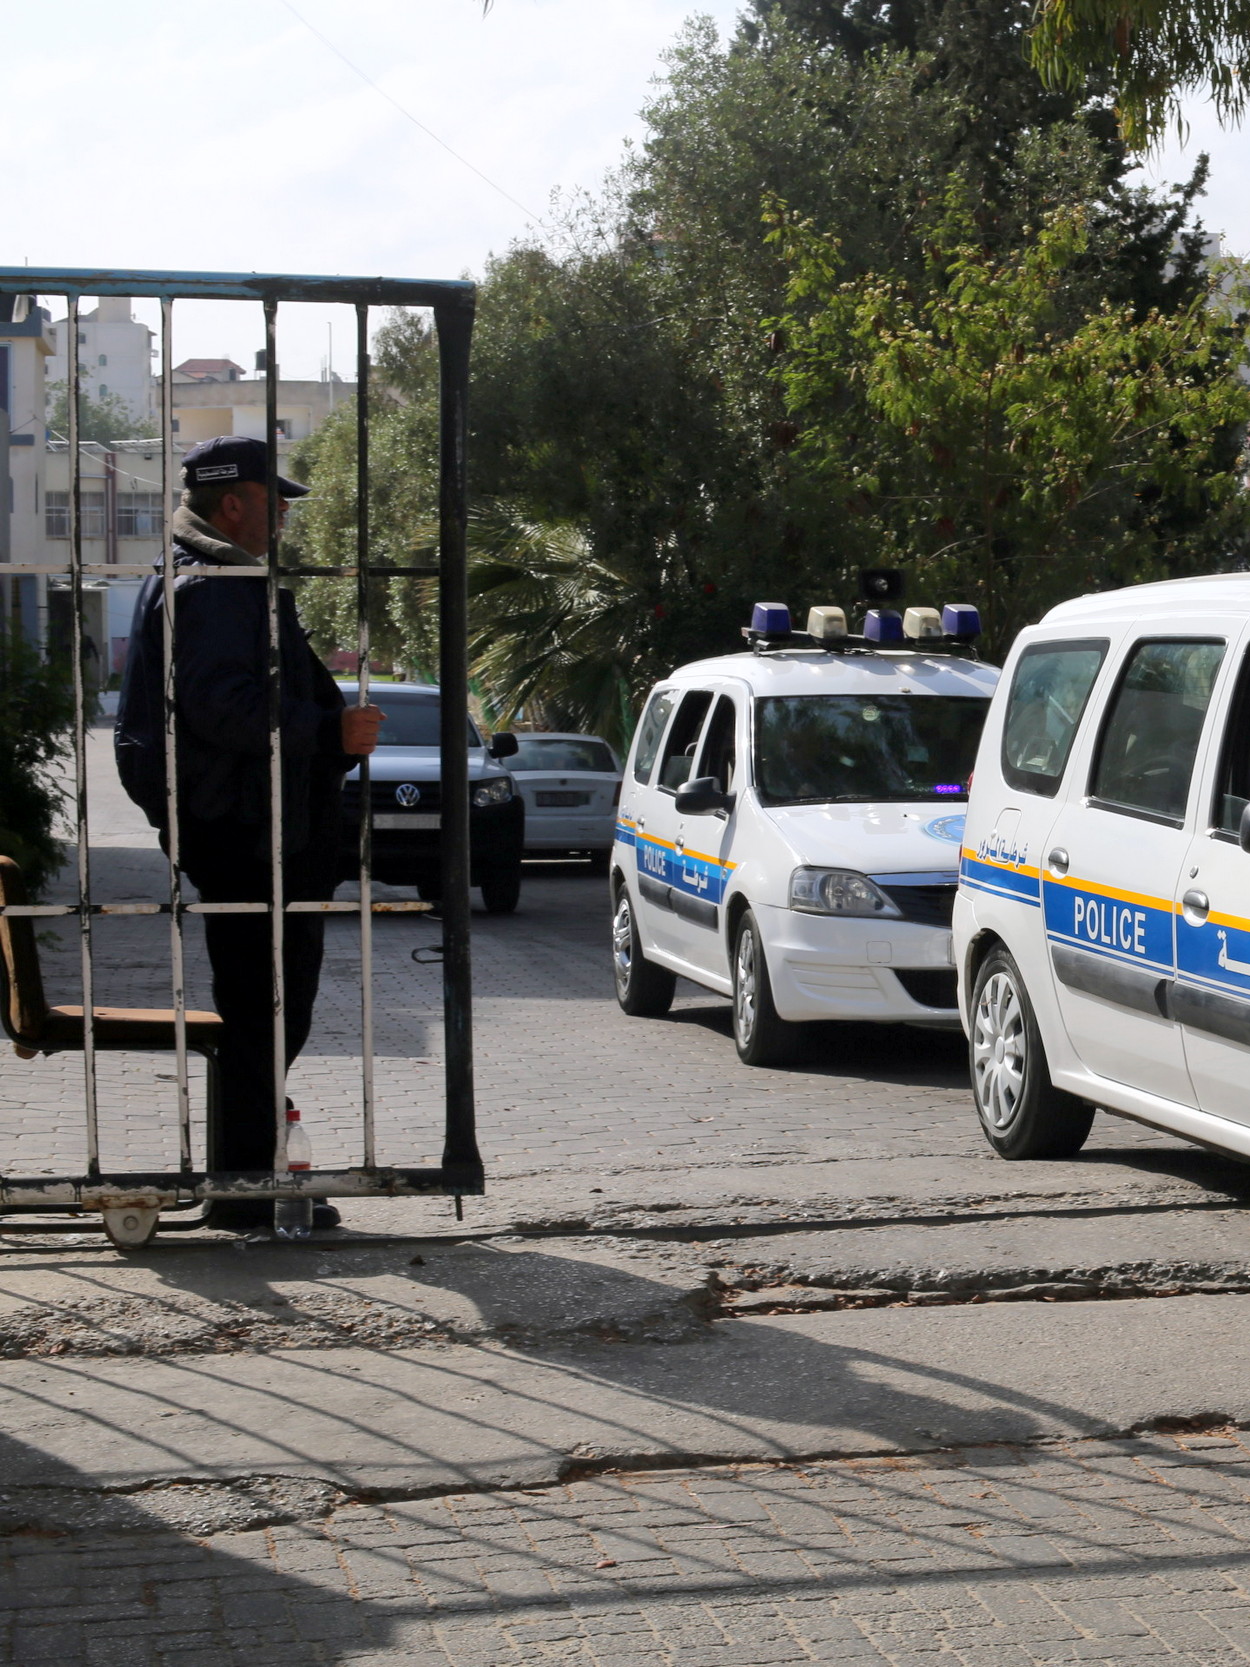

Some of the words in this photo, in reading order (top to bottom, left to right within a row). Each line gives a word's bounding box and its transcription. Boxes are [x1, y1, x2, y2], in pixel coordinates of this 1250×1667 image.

[643, 844, 667, 877] POLICE
[681, 858, 709, 894] شرطة
[1074, 895, 1146, 955] POLICE
